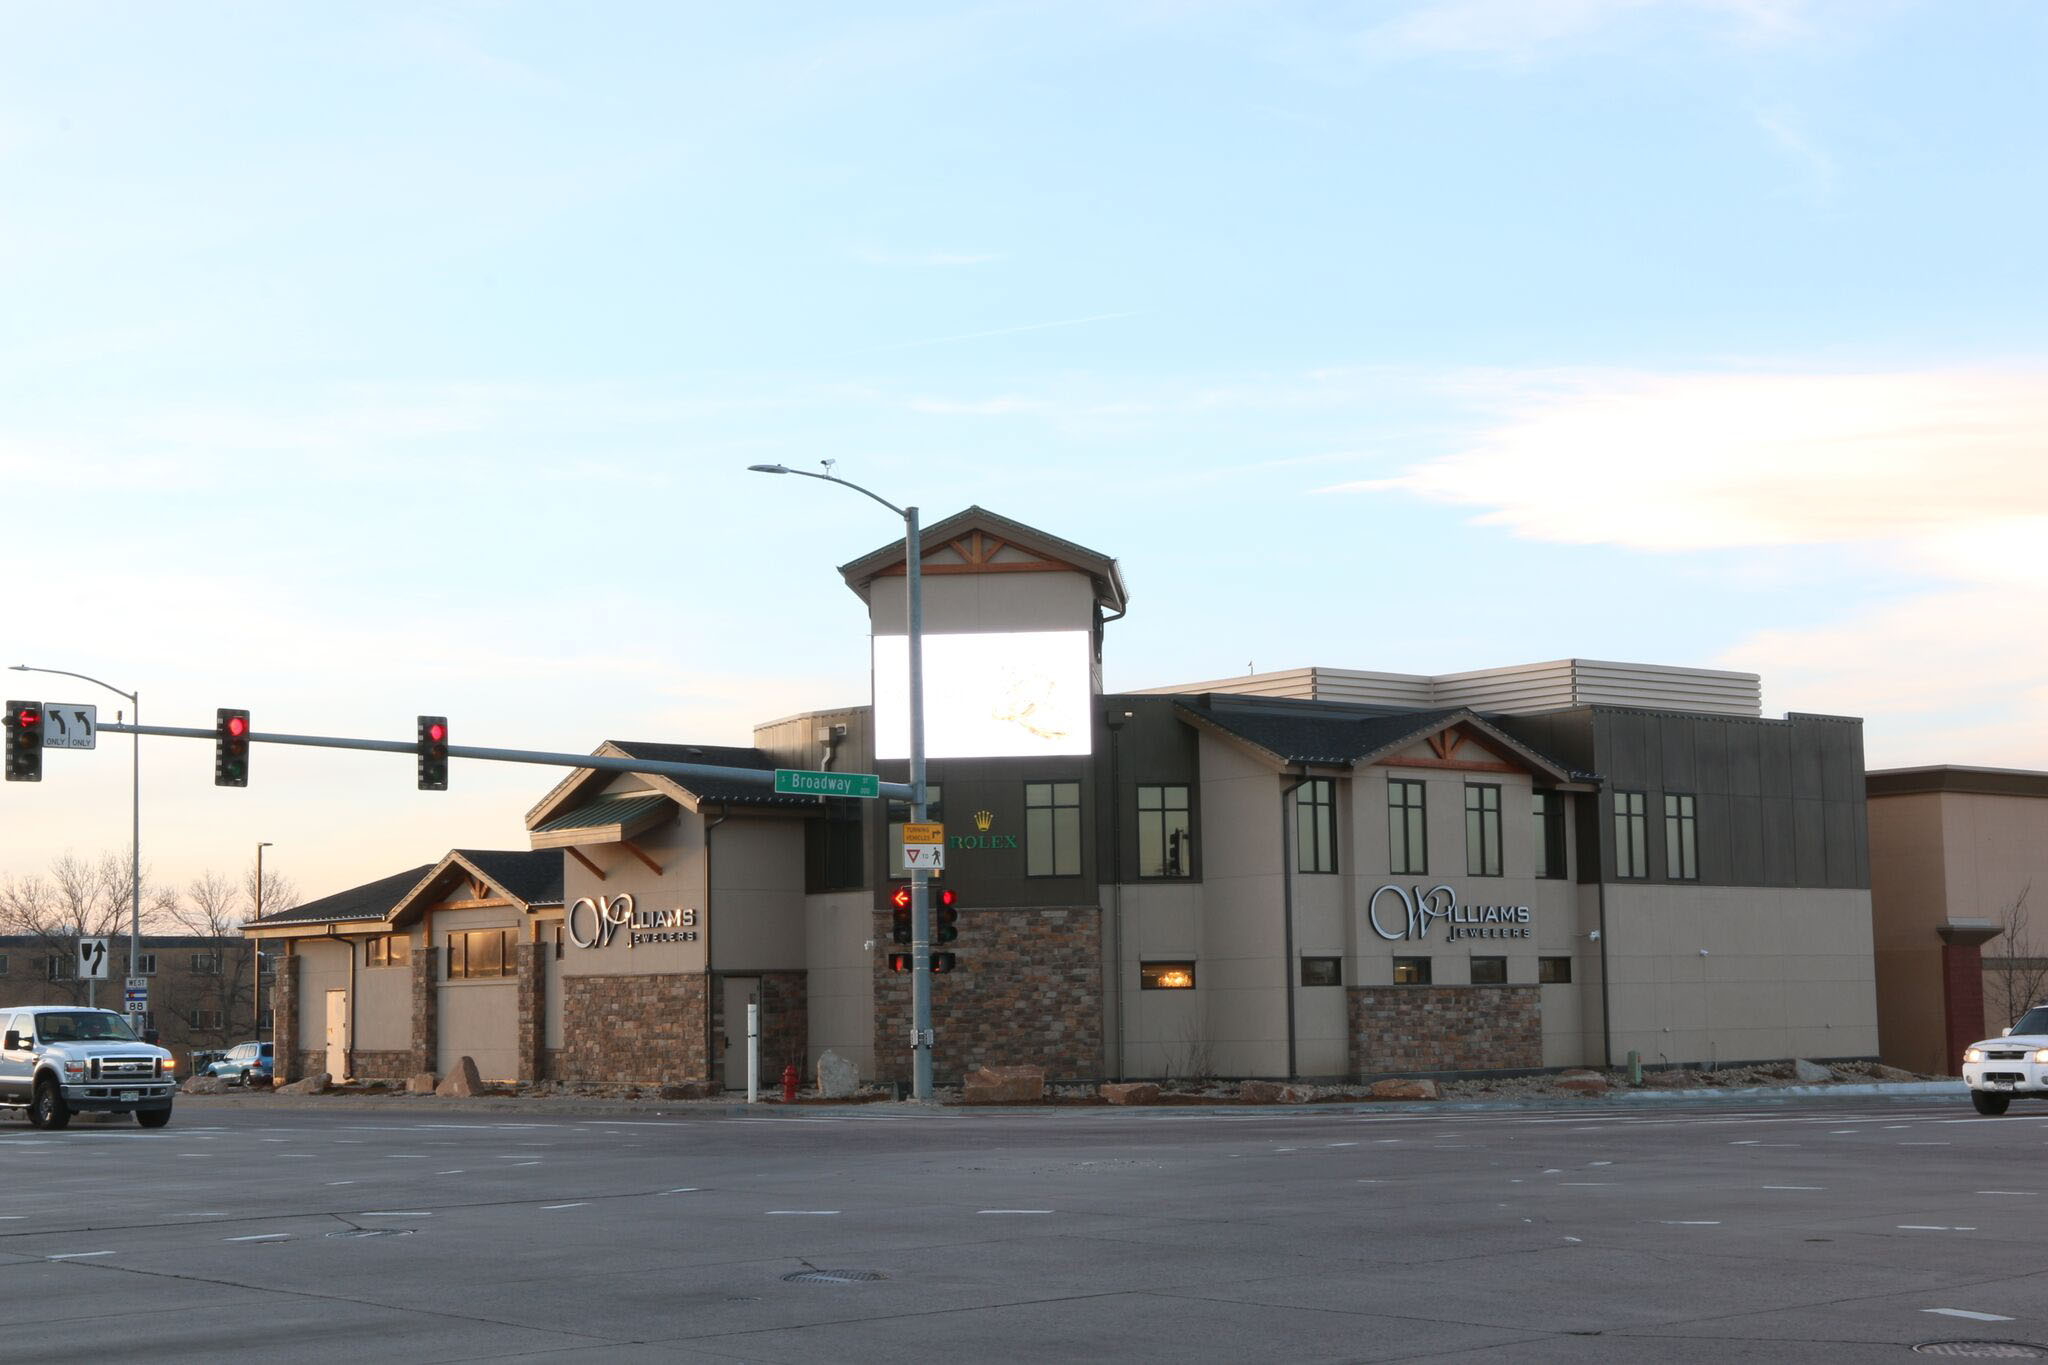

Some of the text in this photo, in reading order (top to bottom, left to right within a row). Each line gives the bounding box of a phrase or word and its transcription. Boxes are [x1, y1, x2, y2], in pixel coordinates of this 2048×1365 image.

[46, 737, 65, 746] ONLY
[72, 739, 91, 747] ONLY
[792, 773, 851, 794] Broadway
[950, 835, 1018, 849] ROLEX
[569, 893, 695, 948] WILLIAMS
[1371, 885, 1530, 940] WILLIAMS
[628, 931, 695, 948] JEWELERS
[1449, 926, 1530, 942] JEWELERS
[129, 1002, 143, 1011] 88
